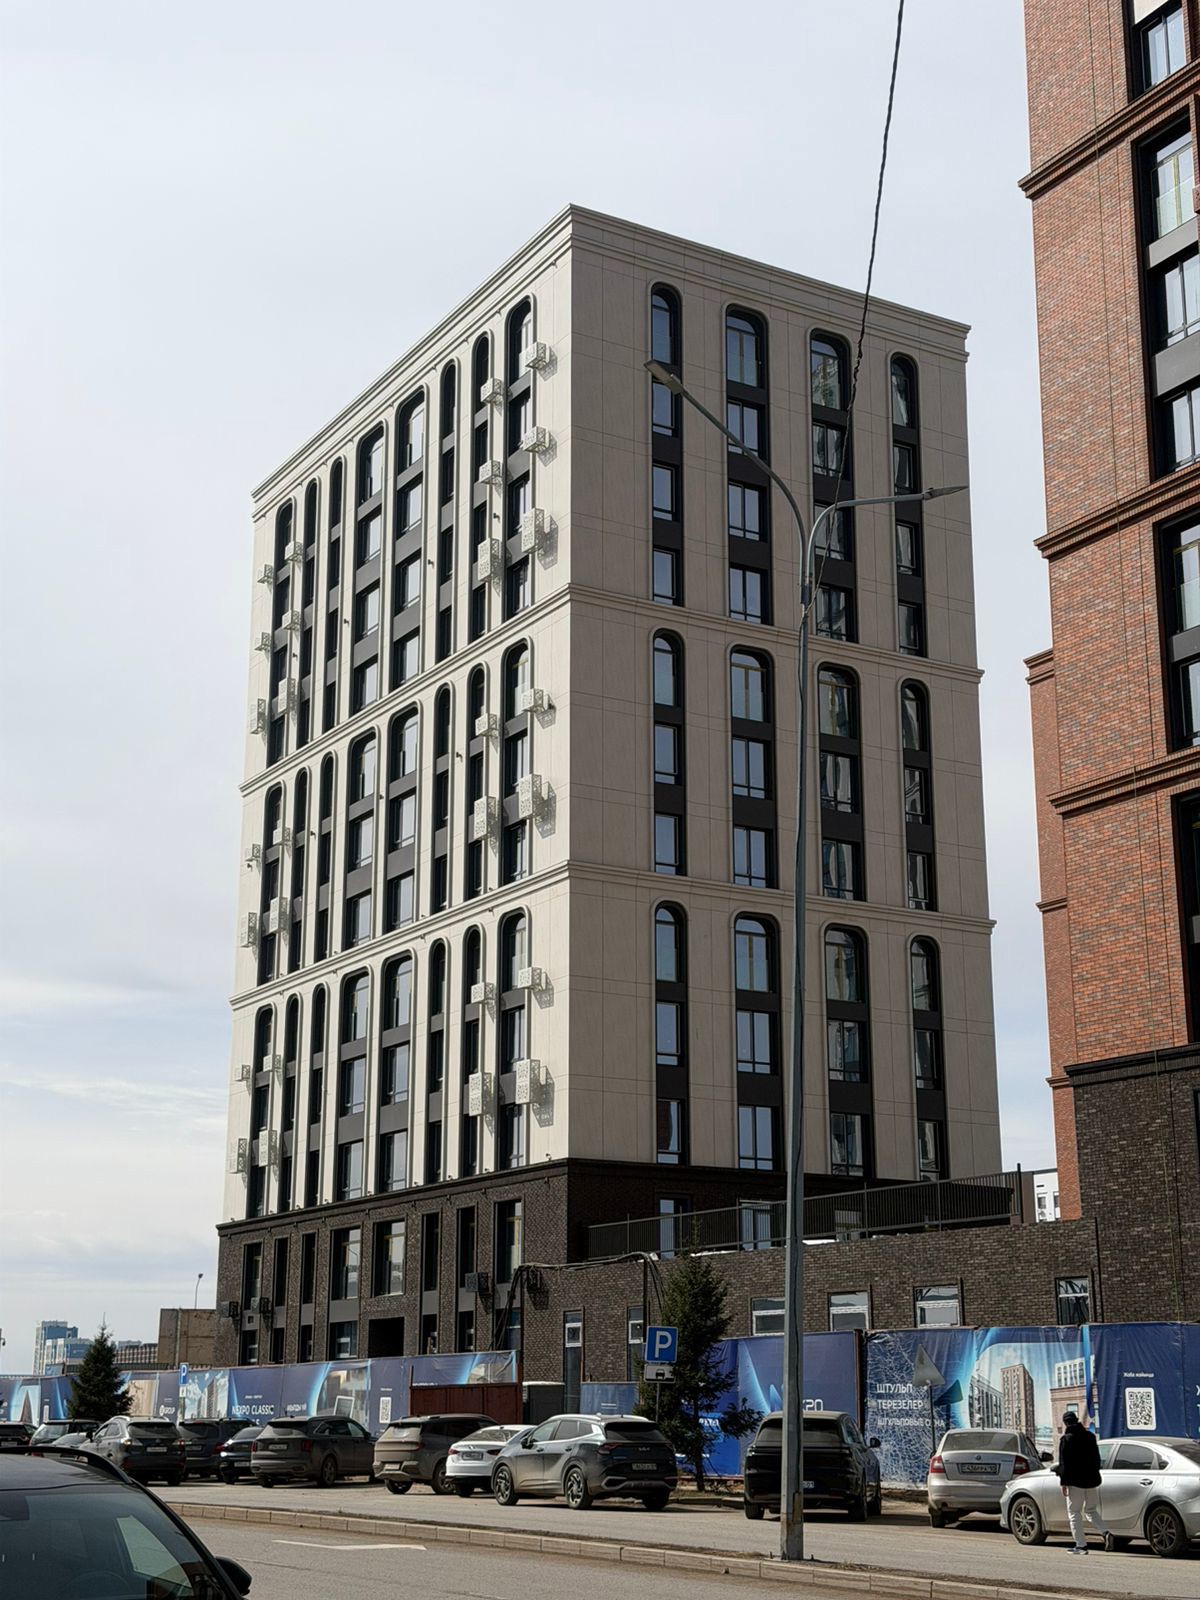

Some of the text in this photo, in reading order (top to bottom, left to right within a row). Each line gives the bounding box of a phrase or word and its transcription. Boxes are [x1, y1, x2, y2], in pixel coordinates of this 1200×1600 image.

[654, 1330, 672, 1358] P
[877, 1383, 913, 1393] ШТУЛЬП
[251, 1404, 275, 1415] CLASSIC
[877, 1399, 923, 1410] ТЕРЕЗЕЛЕР
[925, 1418, 946, 1427] ОНА
